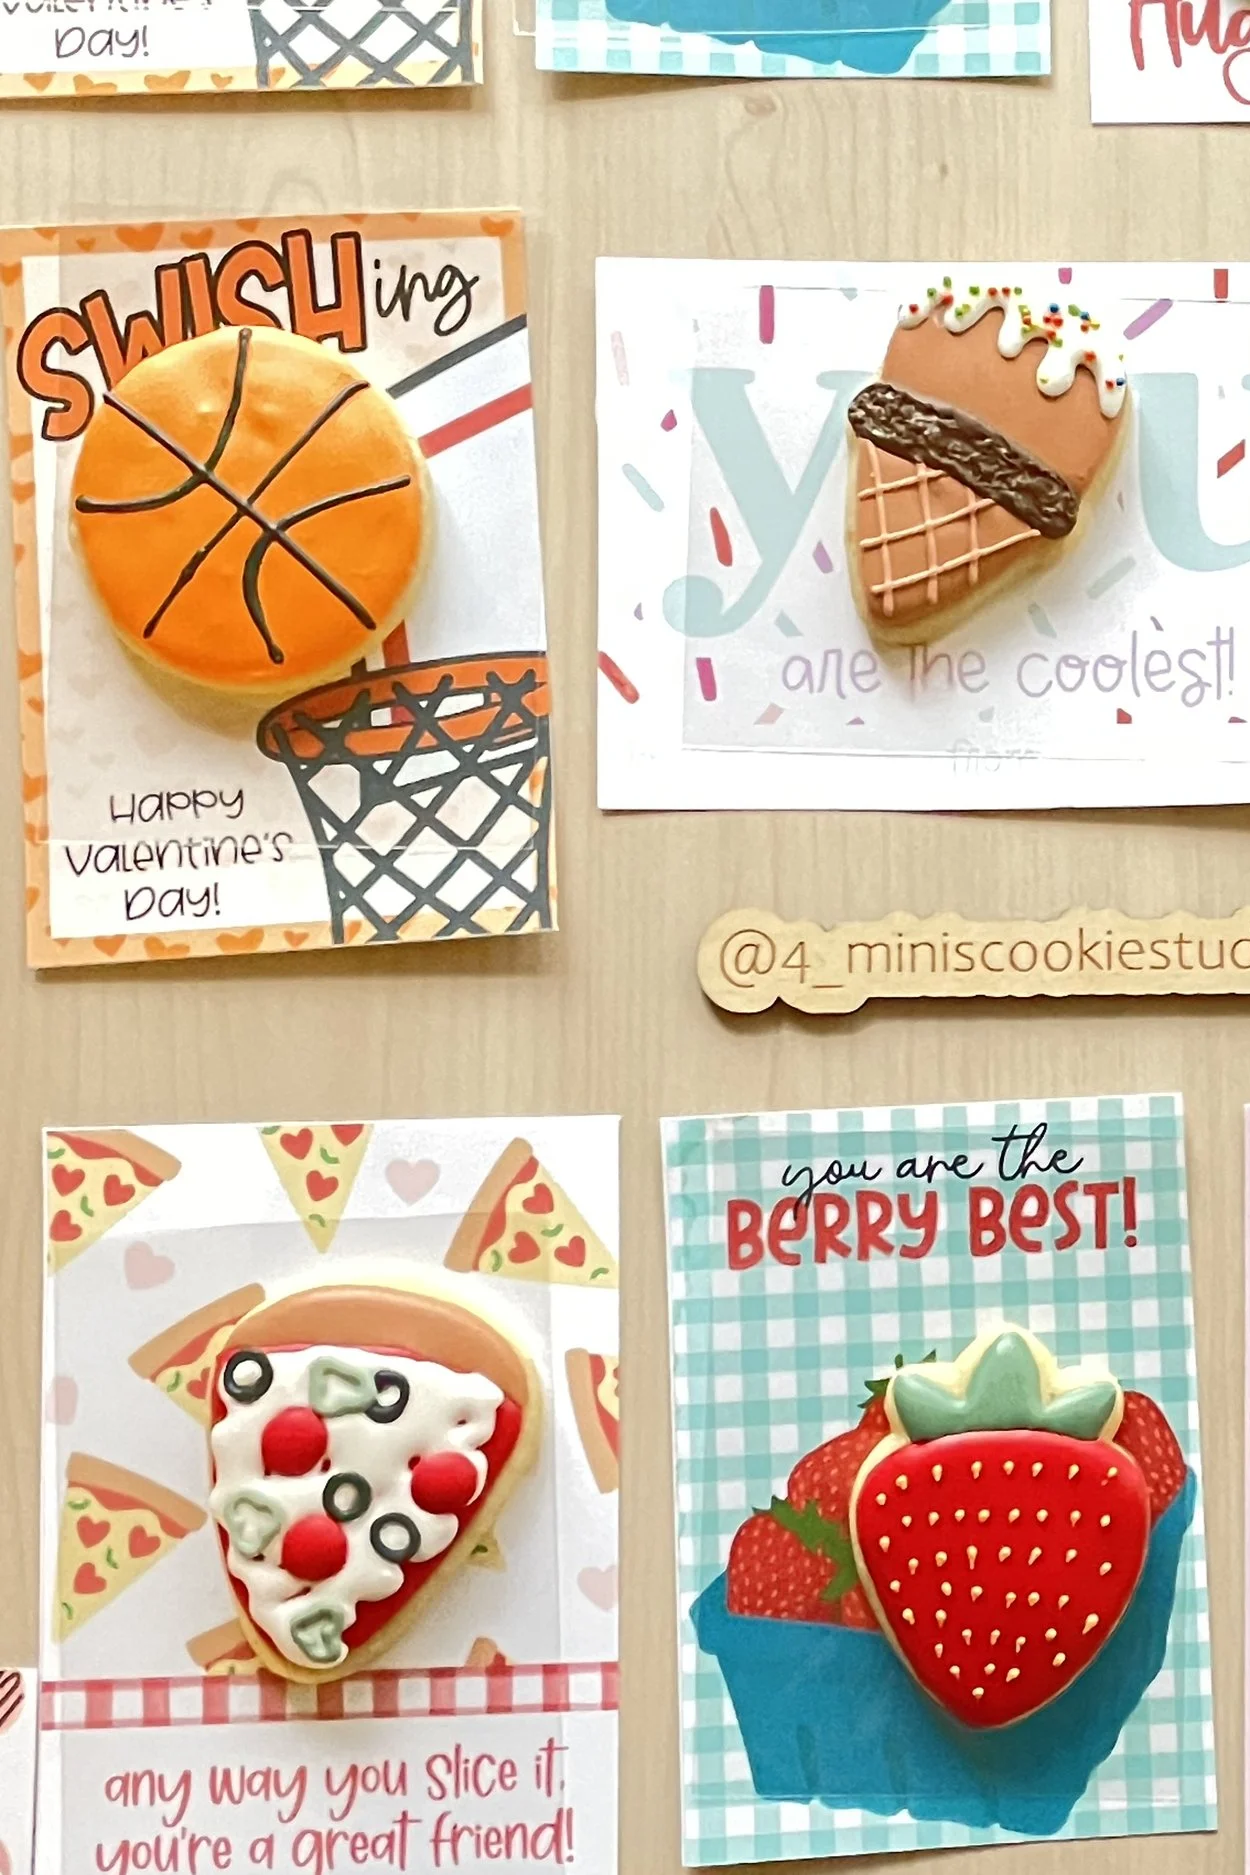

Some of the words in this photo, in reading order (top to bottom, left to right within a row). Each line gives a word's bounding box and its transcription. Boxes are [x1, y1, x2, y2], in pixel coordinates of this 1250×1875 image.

[55, 25, 149, 59] Day!
[782, 648, 881, 699] are
[1017, 626, 1234, 708] coolest!
[110, 789, 244, 824] Happy
[124, 882, 221, 921] Day!
[781, 1162, 883, 1220] you
[896, 1153, 984, 1184] are
[992, 1122, 1084, 1180] the
[104, 1767, 192, 1827] any
[209, 1764, 307, 1824] way
[325, 1760, 407, 1821] you
[95, 1824, 232, 1875] you're
[249, 1834, 274, 1870] a
[292, 1810, 423, 1875] great
[430, 1807, 575, 1869] friend!
